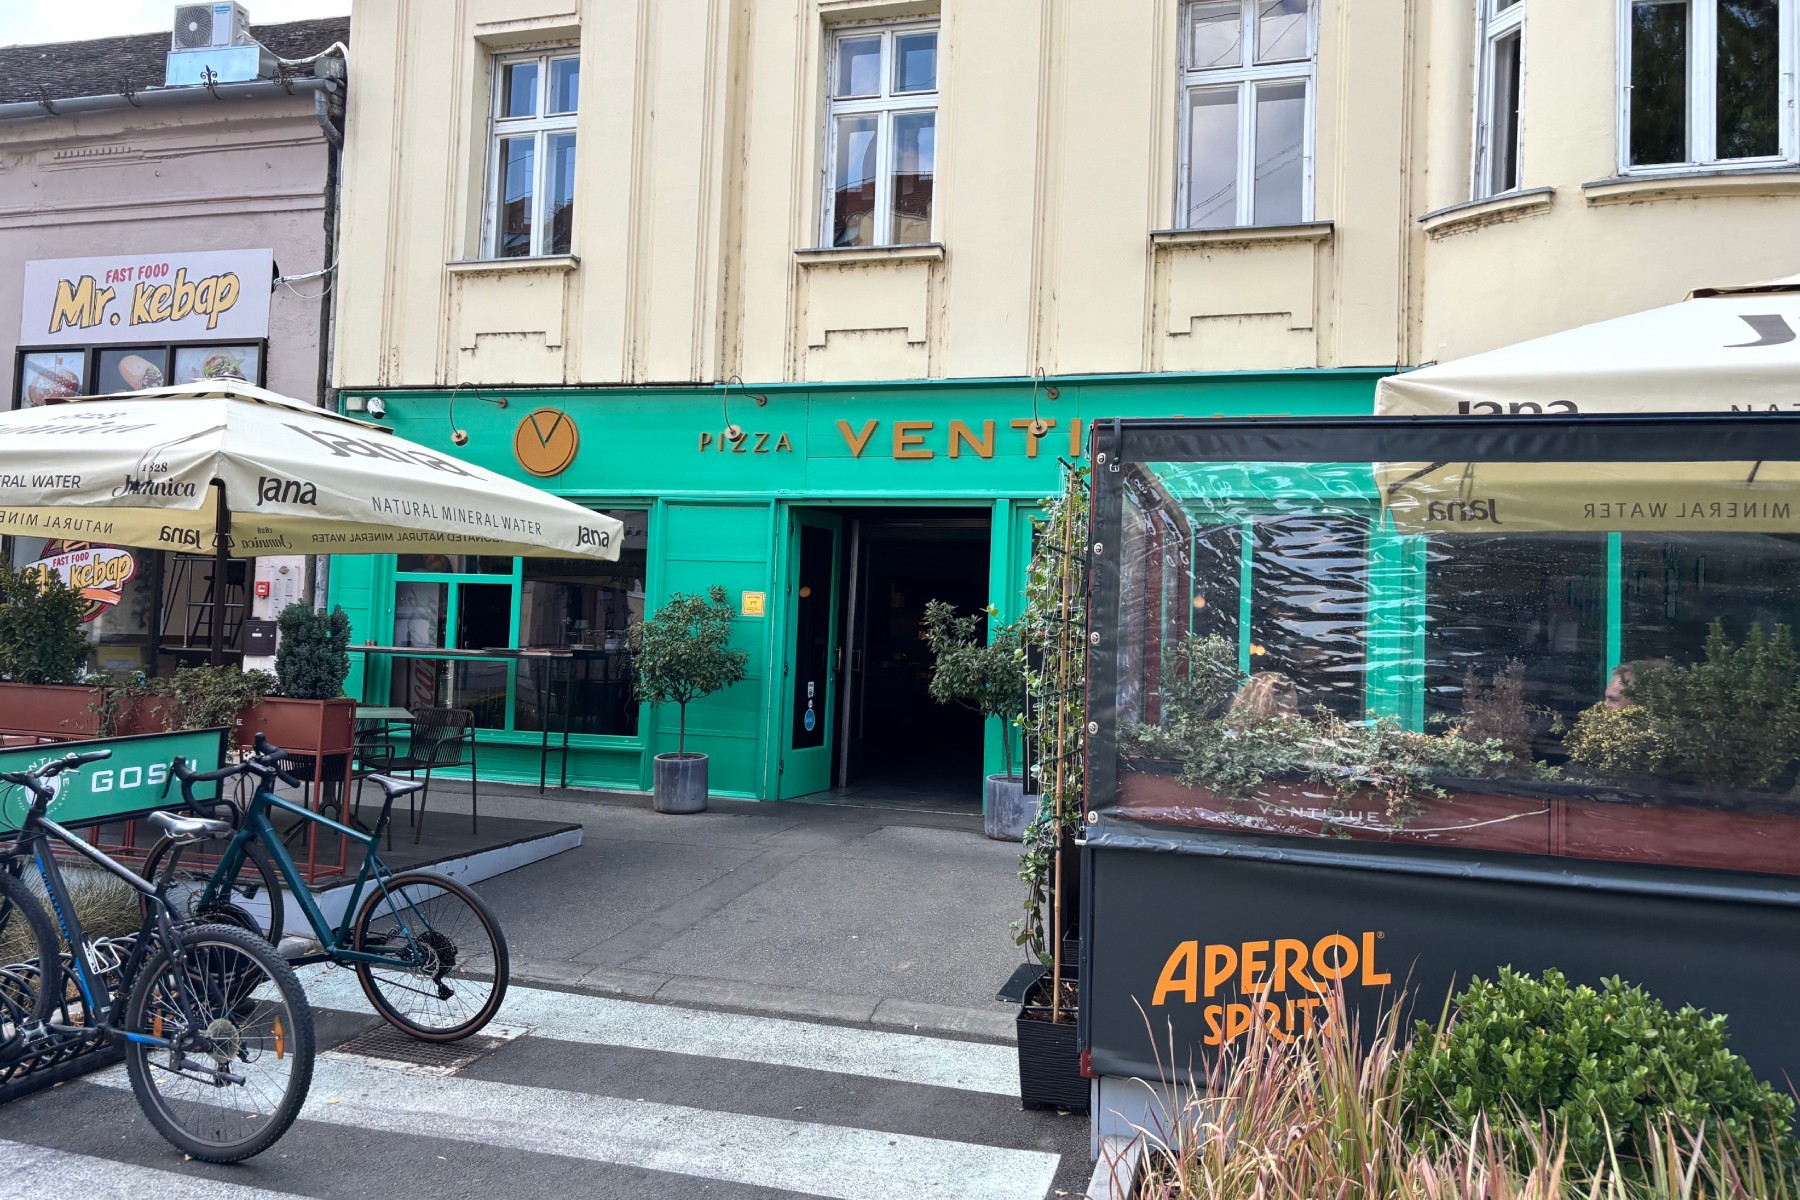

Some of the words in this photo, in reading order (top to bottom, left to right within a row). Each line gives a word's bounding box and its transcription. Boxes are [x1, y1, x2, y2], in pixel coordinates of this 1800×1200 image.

[105, 267, 134, 284] FAST
[138, 263, 169, 280] FOOD
[48, 275, 121, 334] Mr.
[129, 267, 240, 330] kebap
[698, 432, 792, 453] PIZZA
[836, 417, 1083, 459] VENTI
[0, 475, 27, 488] RAL
[32, 475, 82, 488] WATER
[372, 496, 438, 519] NATURAL
[442, 505, 499, 528] MINERAL
[501, 515, 542, 536] WATER
[53, 555, 69, 567] FAST
[71, 552, 90, 564] FOOD
[70, 553, 134, 592] kebap
